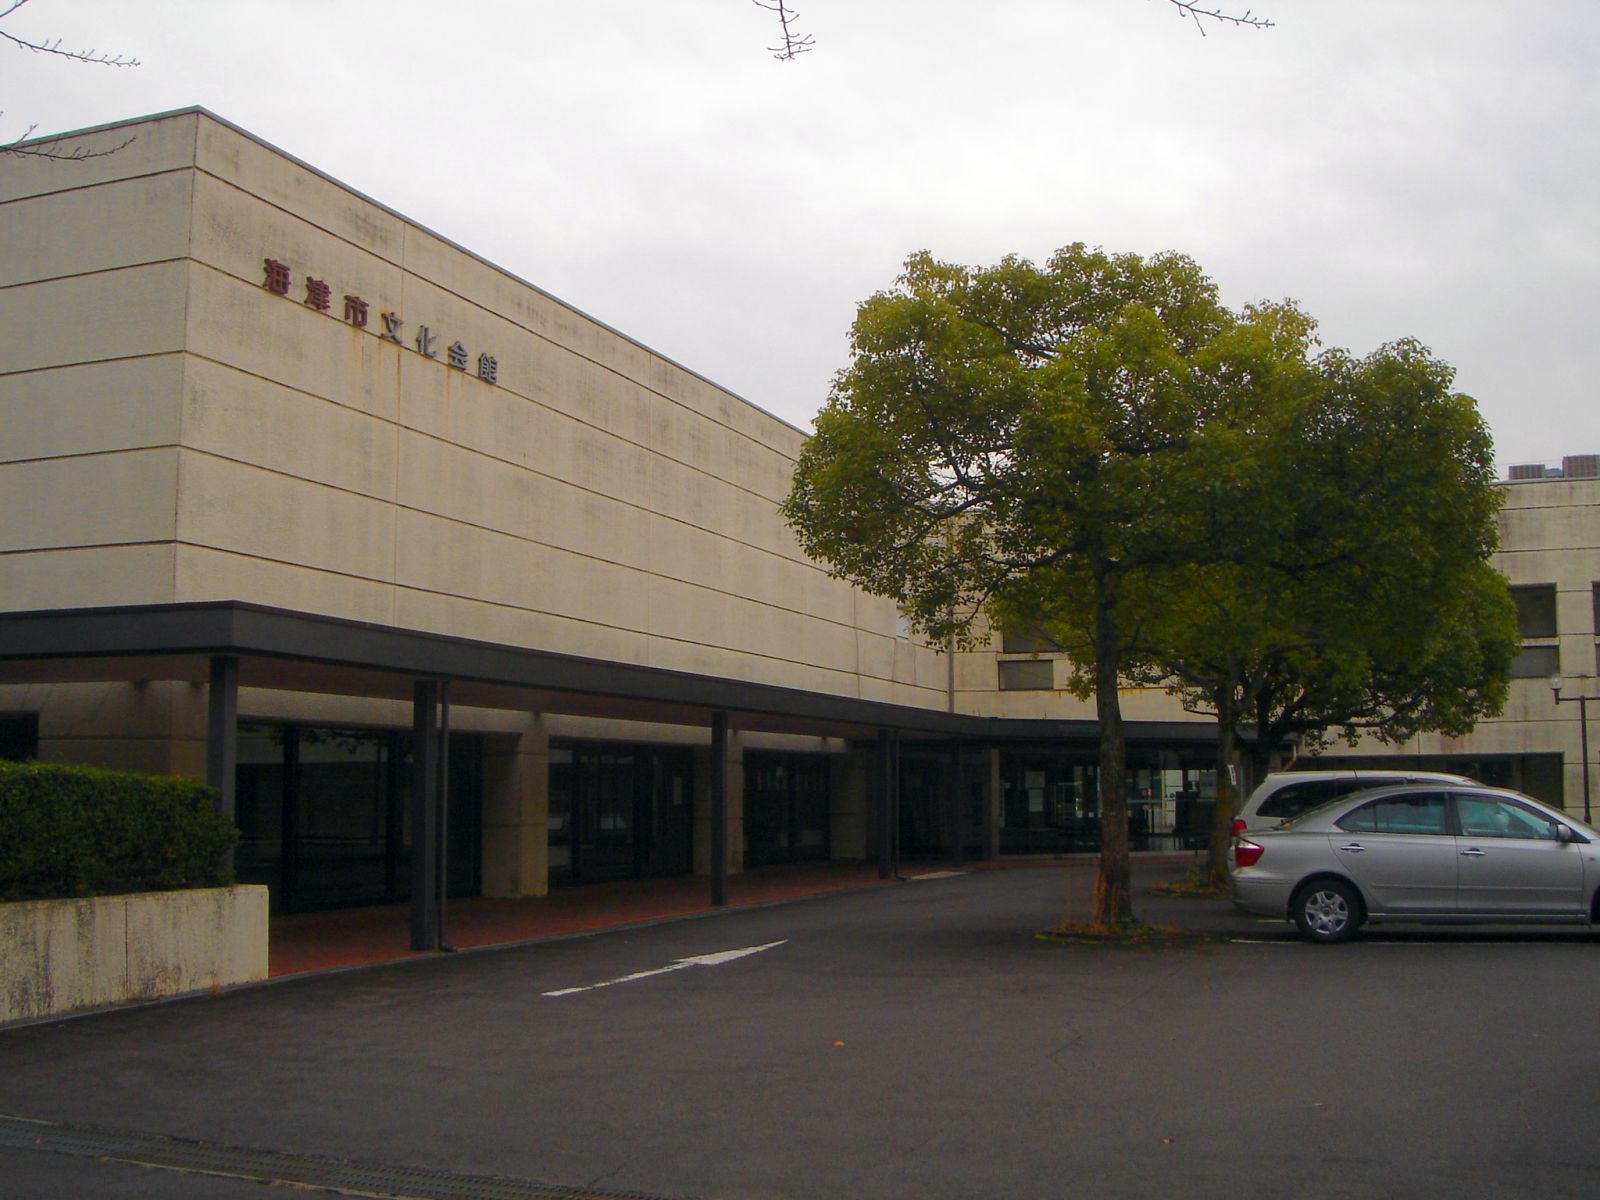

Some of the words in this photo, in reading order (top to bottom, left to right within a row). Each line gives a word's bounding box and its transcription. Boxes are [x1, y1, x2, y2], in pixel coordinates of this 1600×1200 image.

[263, 258, 498, 385] 海津市文化会館
